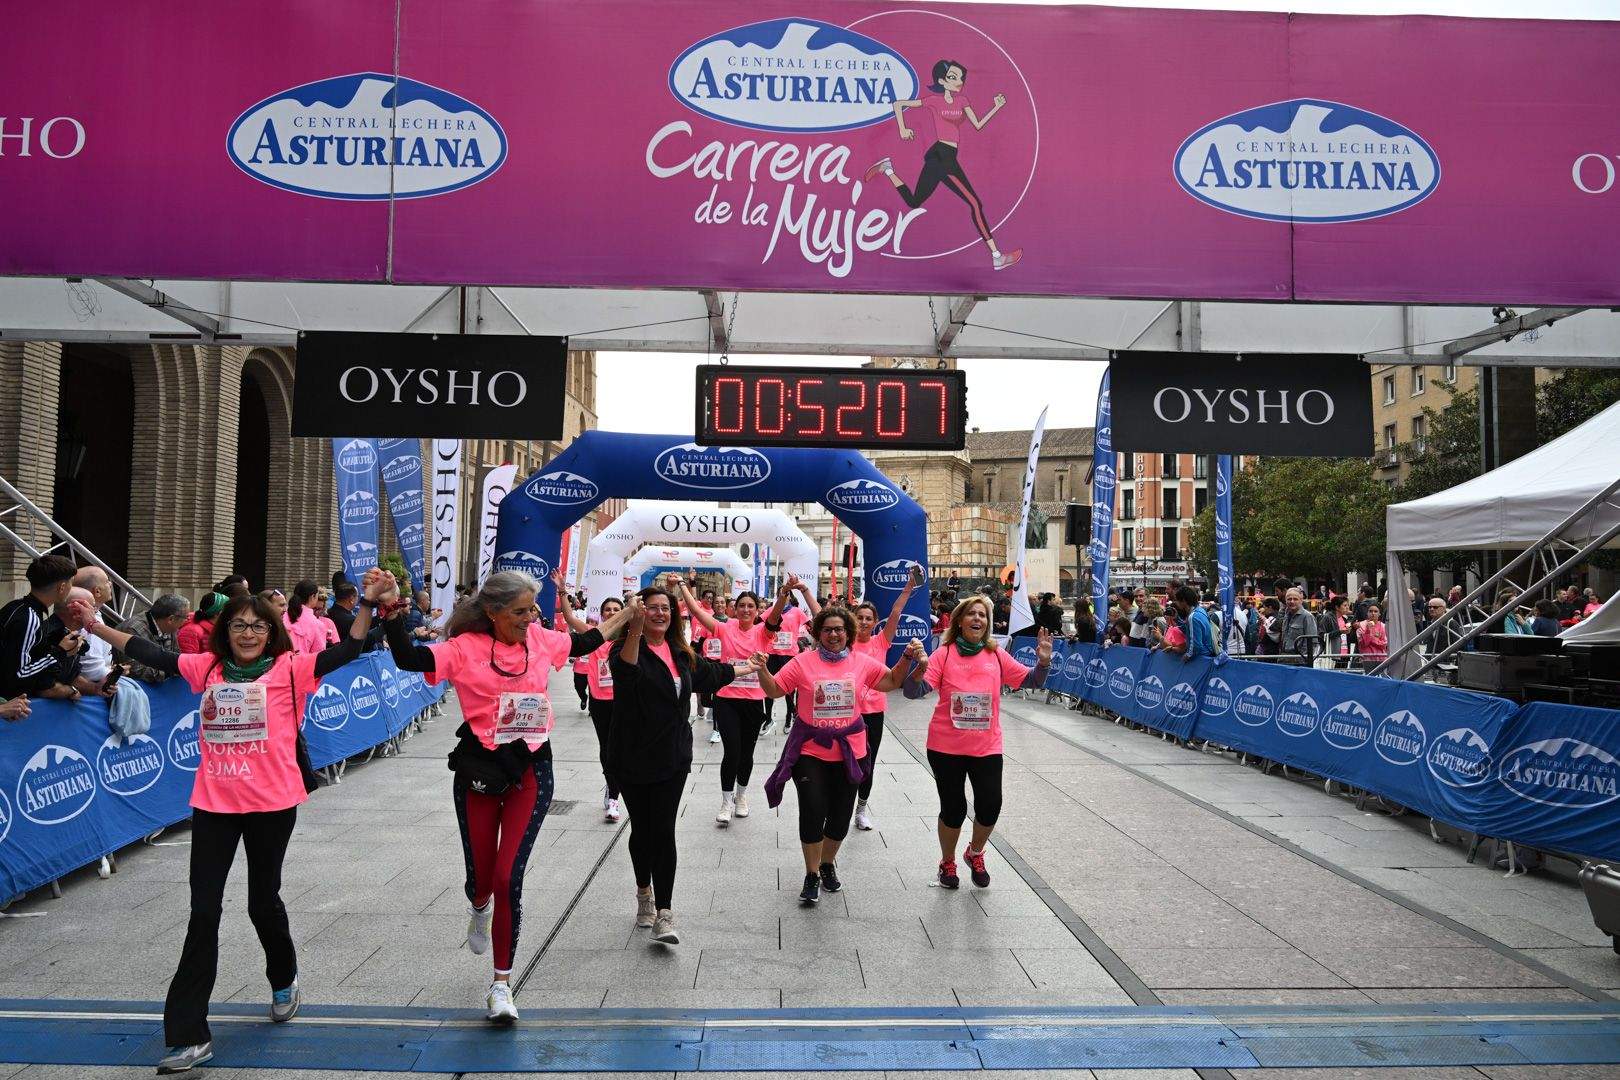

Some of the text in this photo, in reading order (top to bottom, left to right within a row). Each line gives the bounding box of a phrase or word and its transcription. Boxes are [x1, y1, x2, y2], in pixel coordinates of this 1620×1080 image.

[727, 56, 892, 71] CENTRAL LECHERA
[293, 116, 478, 131] CENTRAL LECHERA
[645, 121, 850, 184] Carrera
[1236, 140, 1412, 155] CENTRAL LECHERA
[694, 181, 927, 278] de la Mujer
[339, 365, 527, 408] OYSHO
[1152, 386, 1335, 426] OYSHO
[1137, 454, 1145, 501] HOTEL
[434, 438, 460, 590] OYSHO
[660, 514, 751, 534] OYSHO
[605, 533, 634, 541] OYSHO
[775, 535, 803, 543] OYSHO
[219, 706, 242, 716] 016
[515, 712, 534, 721] 016
[102, 753, 161, 784] ASTURIANA
[26, 772, 93, 814] ASTURIANA
